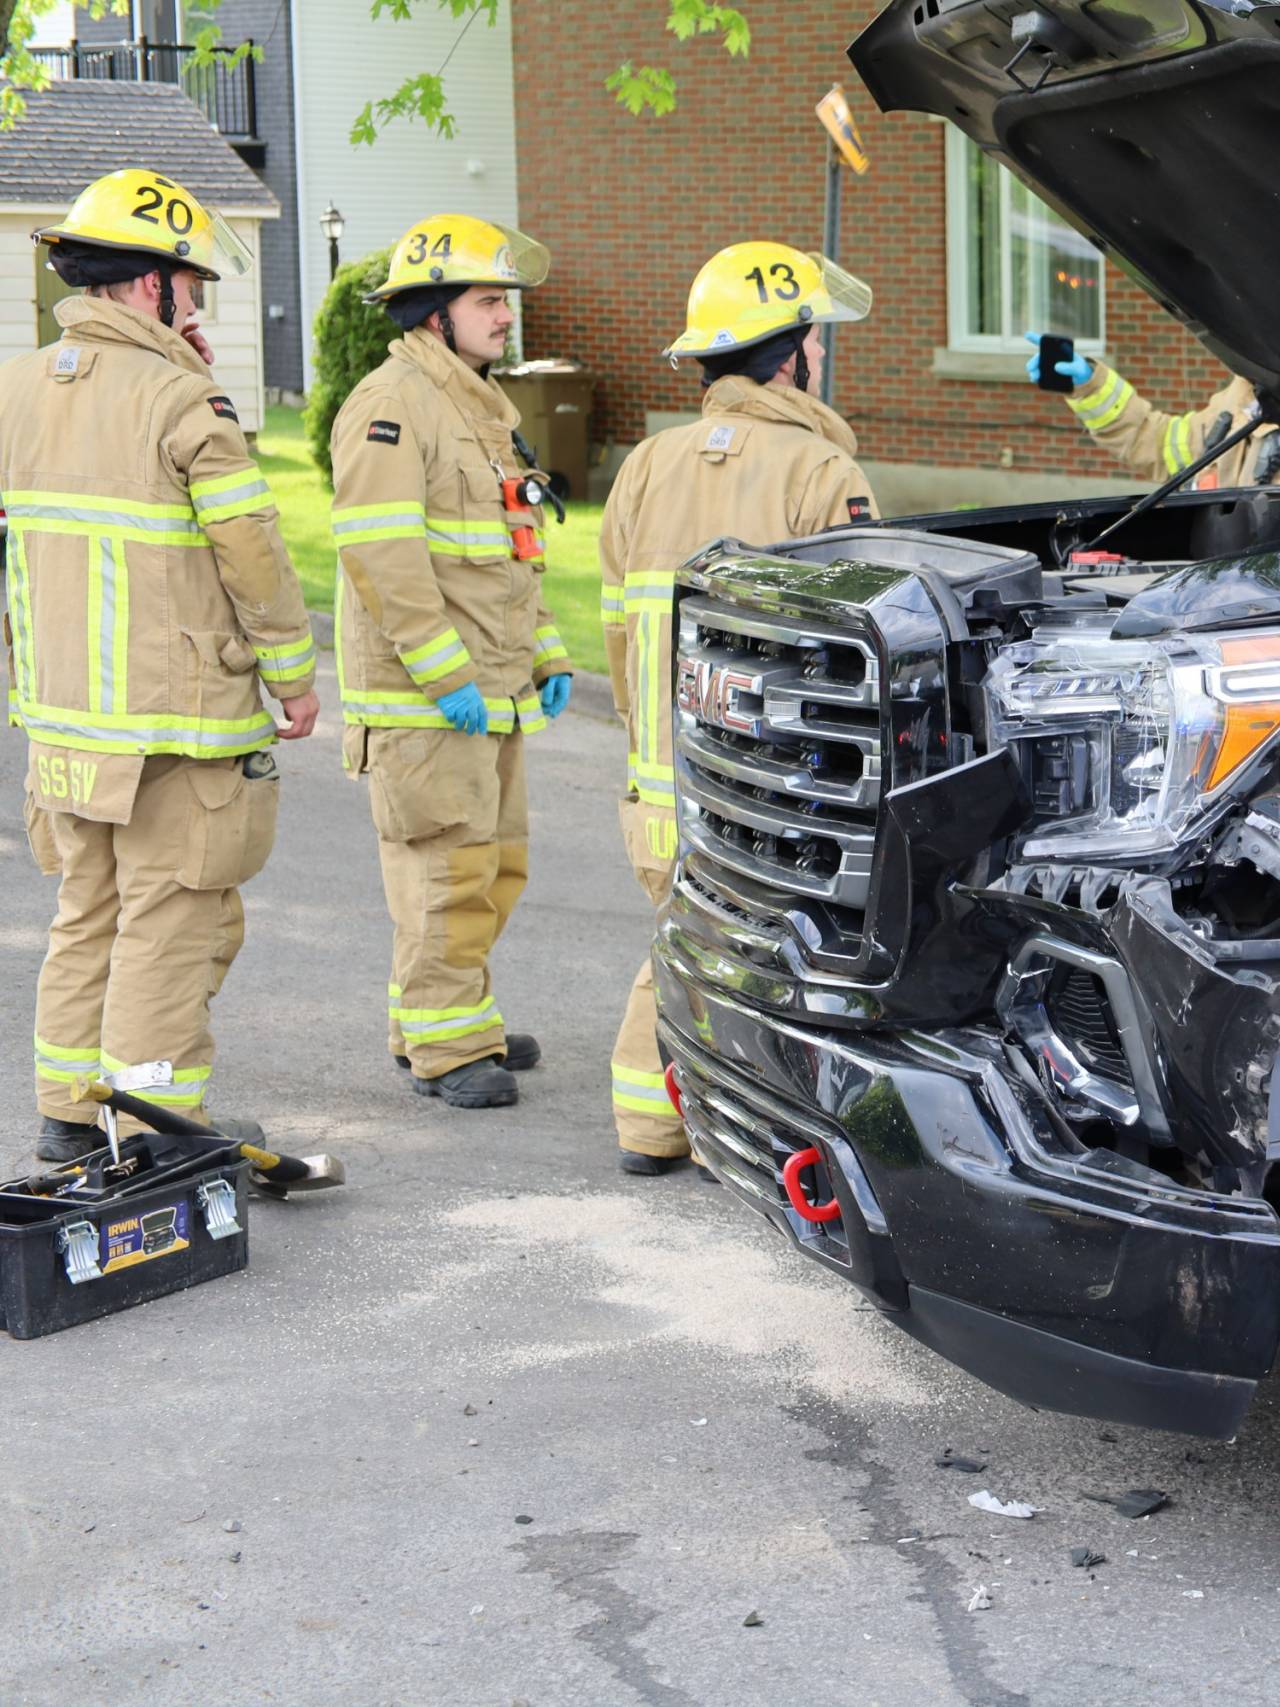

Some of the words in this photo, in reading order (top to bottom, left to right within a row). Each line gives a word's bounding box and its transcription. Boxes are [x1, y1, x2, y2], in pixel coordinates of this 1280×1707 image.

[131, 186, 192, 235] 20
[407, 233, 452, 265] 34
[745, 263, 800, 303] 13
[678, 658, 763, 738] GMC
[108, 1218, 139, 1237] IRWIN
